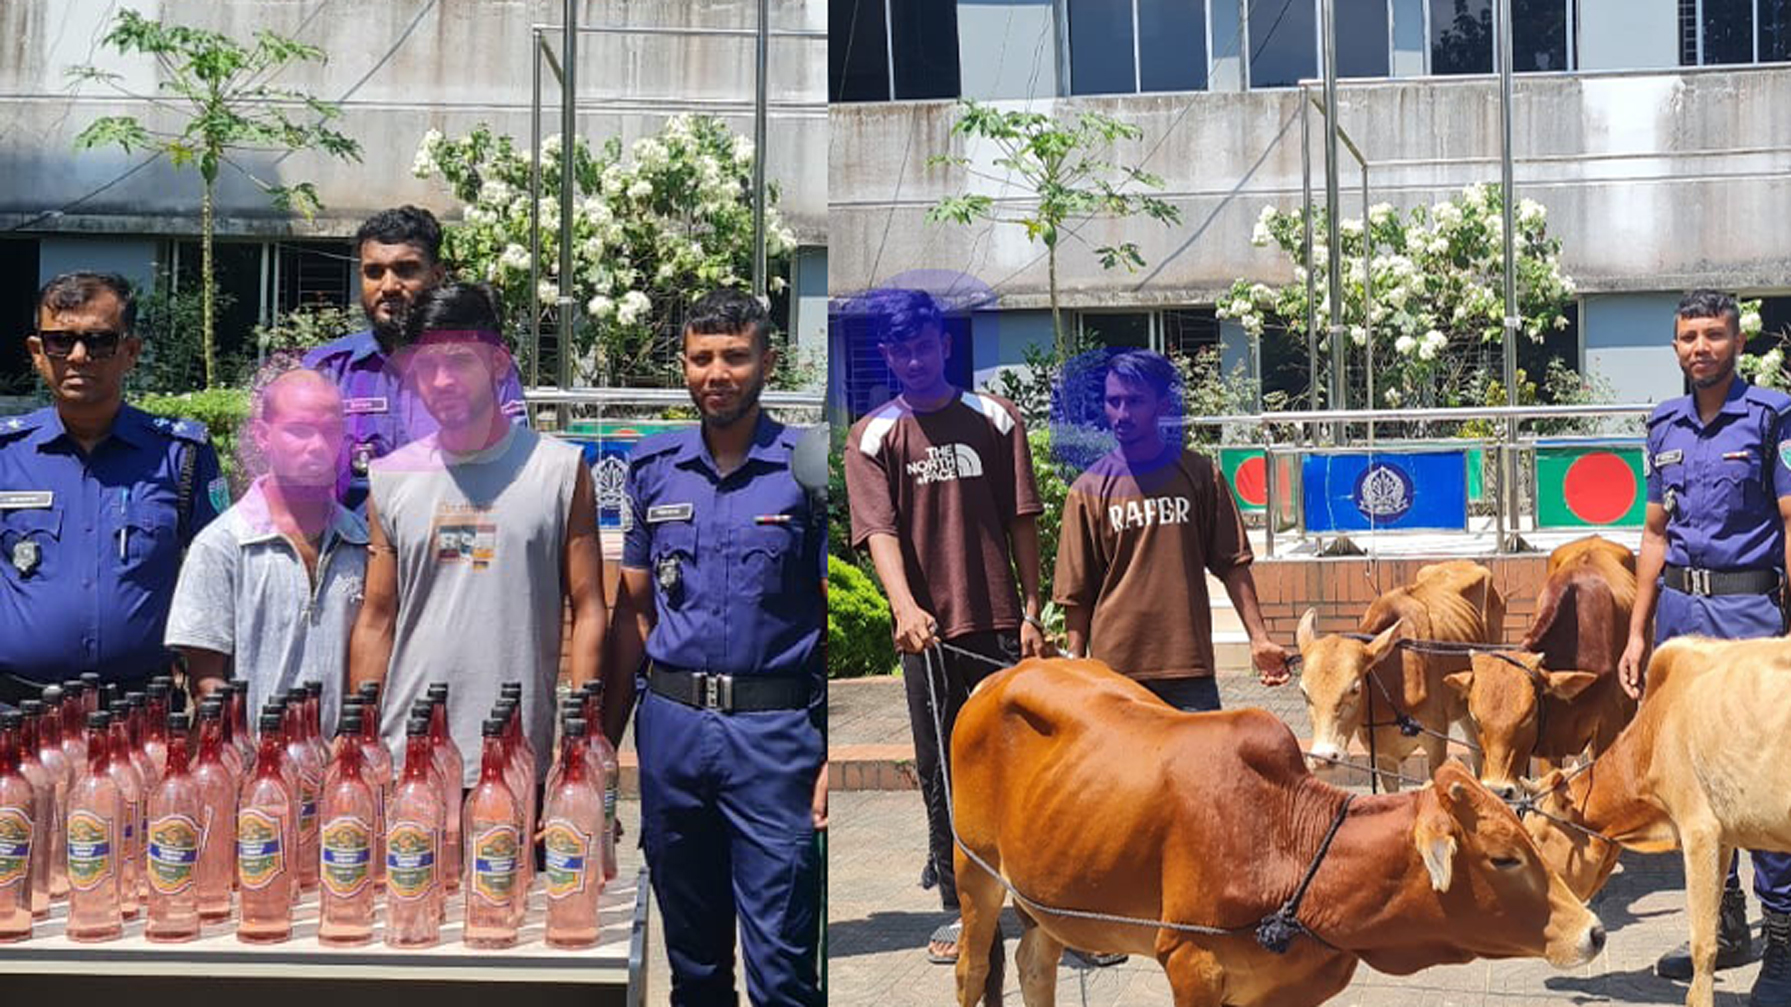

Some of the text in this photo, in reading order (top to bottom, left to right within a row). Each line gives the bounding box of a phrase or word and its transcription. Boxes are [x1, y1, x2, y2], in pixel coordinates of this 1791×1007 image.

[925, 444, 953, 460] THE
[906, 455, 956, 475] NORTH
[922, 469, 957, 484] FACE
